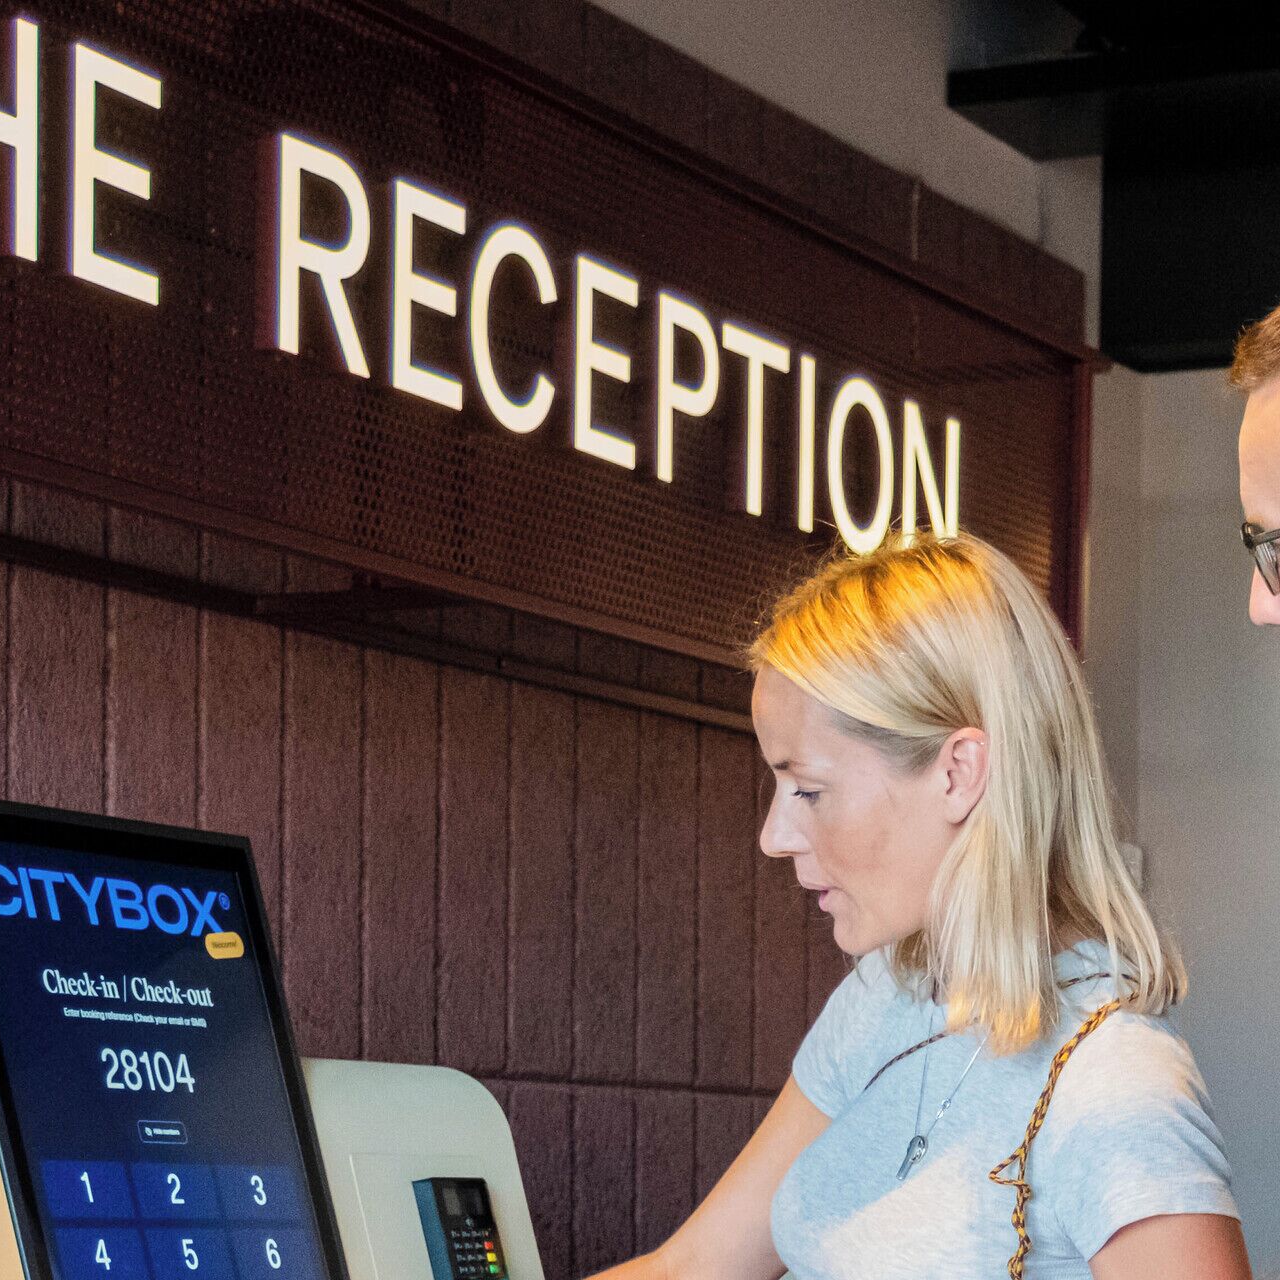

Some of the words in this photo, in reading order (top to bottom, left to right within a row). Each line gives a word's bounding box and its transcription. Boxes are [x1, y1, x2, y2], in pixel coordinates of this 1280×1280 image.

[277, 133, 963, 555] RECEPTION
[42, 968, 121, 1000] Check-in
[131, 976, 215, 1007] Check-out
[100, 1047, 196, 1094] 28104
[80, 1171, 94, 1203] 1
[166, 1172, 186, 1205] 2
[250, 1174, 268, 1206] 3
[95, 1238, 112, 1271] 4
[181, 1238, 199, 1270] 5
[265, 1238, 282, 1270] 6
